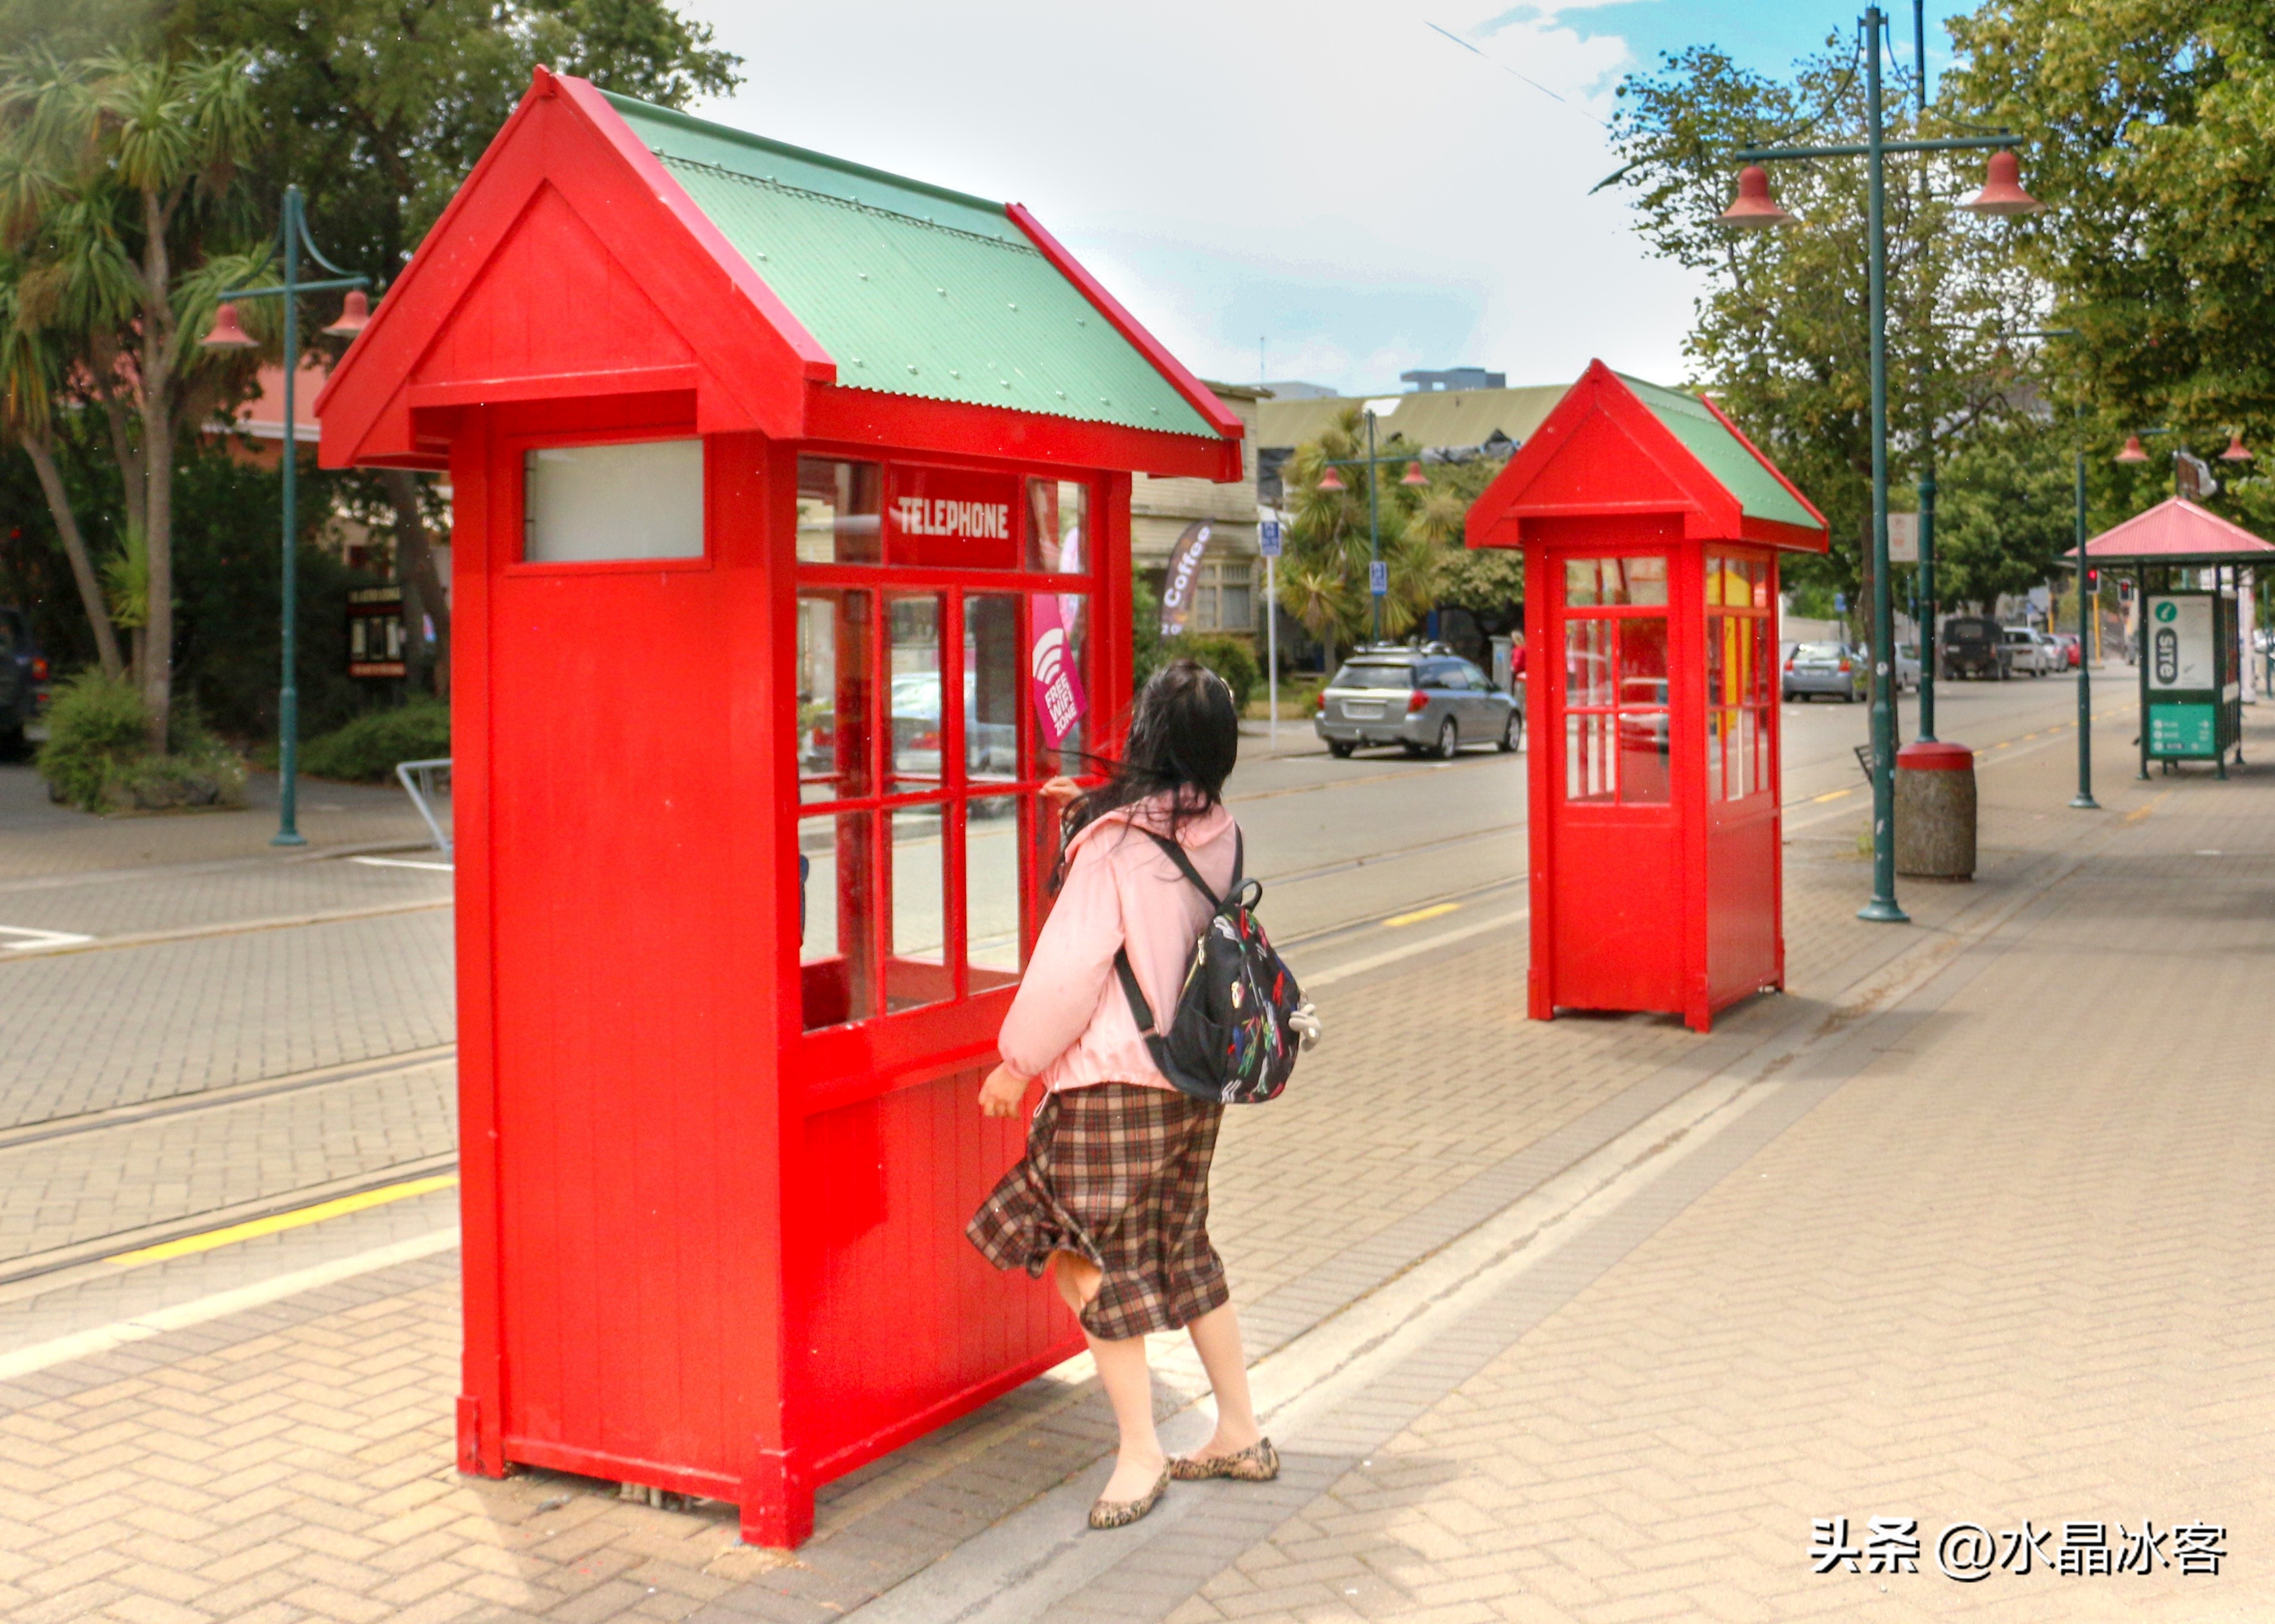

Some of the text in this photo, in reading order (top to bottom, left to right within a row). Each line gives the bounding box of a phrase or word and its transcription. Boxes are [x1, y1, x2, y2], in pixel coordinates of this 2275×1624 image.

[898, 496, 1008, 540] TELEPHONE
[1163, 526, 1211, 608] Coffee
[1045, 672, 1069, 709] FREE
[1054, 702, 1077, 737] ZONE
